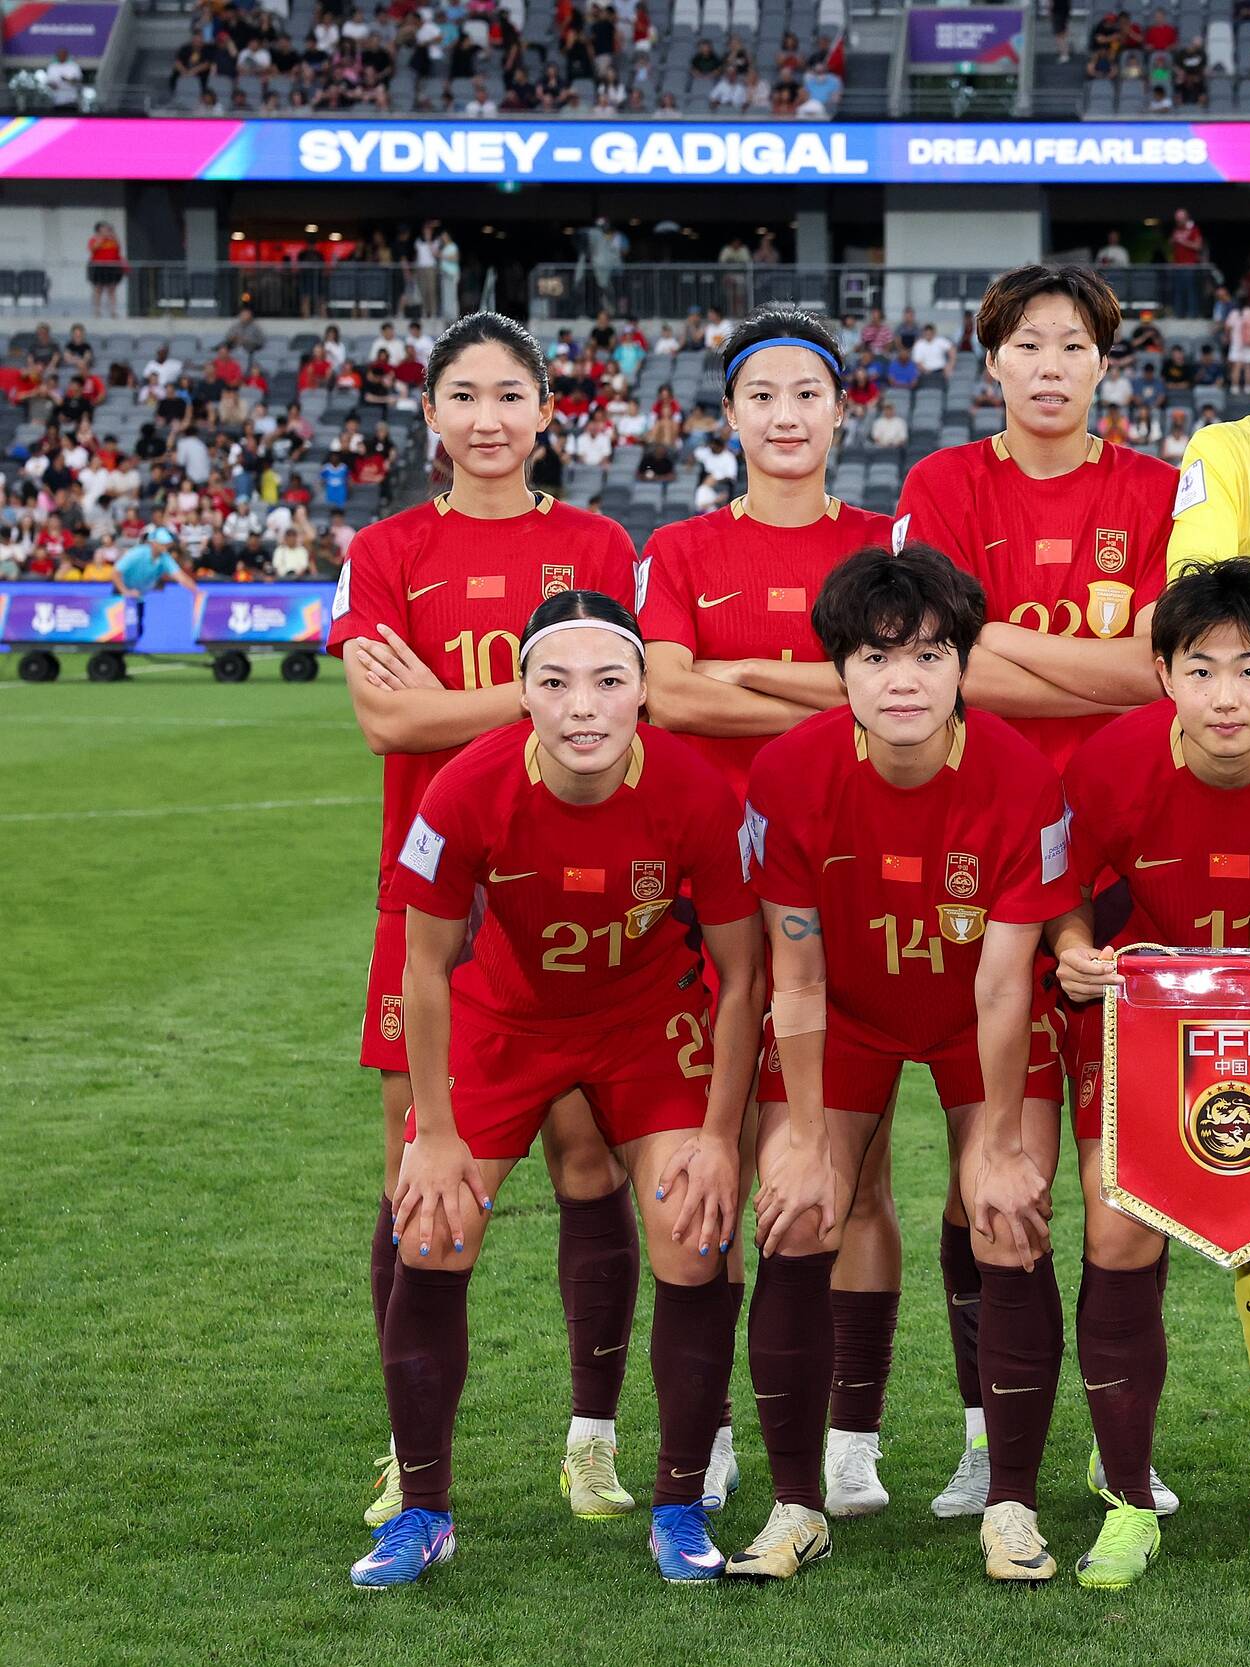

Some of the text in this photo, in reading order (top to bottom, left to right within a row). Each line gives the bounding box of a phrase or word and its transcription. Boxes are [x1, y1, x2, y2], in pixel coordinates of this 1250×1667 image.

[299, 131, 547, 173] SYDNEY
[591, 132, 868, 173] GADIGAL
[907, 138, 1208, 165] DREAM FEARLESS
[1099, 532, 1124, 541] CFA
[545, 567, 571, 576] CFA
[445, 630, 520, 691] 10
[635, 863, 663, 871] CFA
[950, 855, 976, 867] CFA
[541, 922, 622, 973] 21
[870, 914, 945, 975] 14
[383, 997, 401, 1007] CFA
[666, 1008, 714, 1079] 2
[1215, 1059, 1248, 1076] 中国
